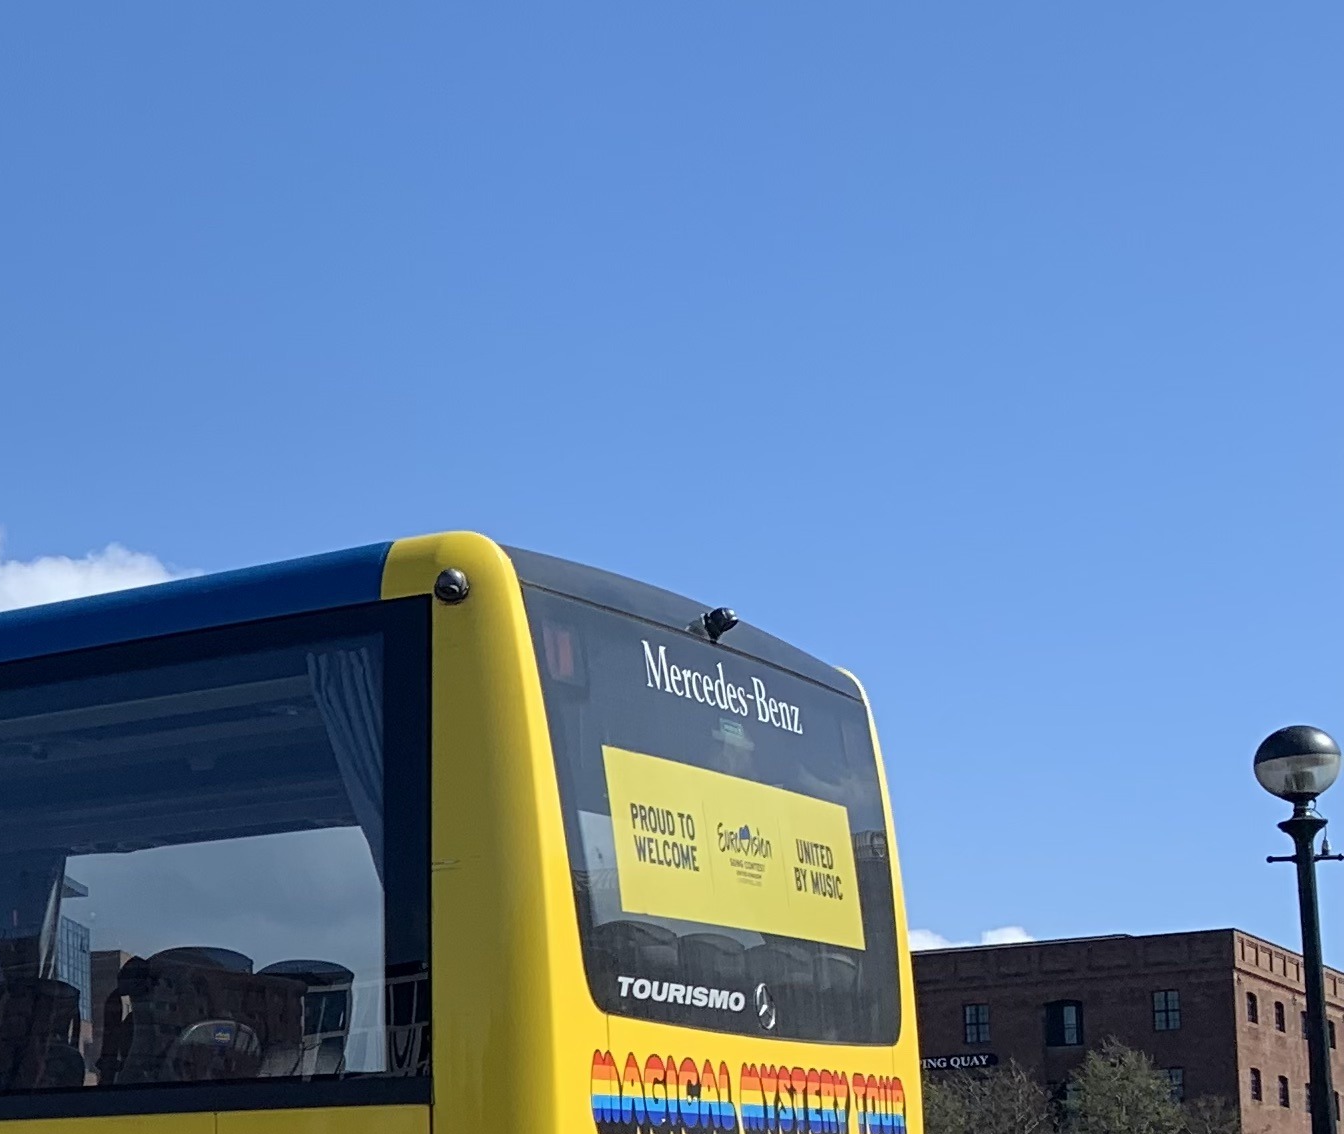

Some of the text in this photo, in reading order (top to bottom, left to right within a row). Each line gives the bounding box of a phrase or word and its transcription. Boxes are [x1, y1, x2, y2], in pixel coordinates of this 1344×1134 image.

[641, 639, 804, 735] Mercedes-Benz
[630, 802, 696, 841] PROUD TO
[633, 834, 700, 873] WELCOME
[796, 838, 834, 870] UNITED
[794, 865, 844, 901] BY MUSIC
[617, 976, 746, 1013] TOURISMO
[920, 1054, 989, 1069] ING QUAY
